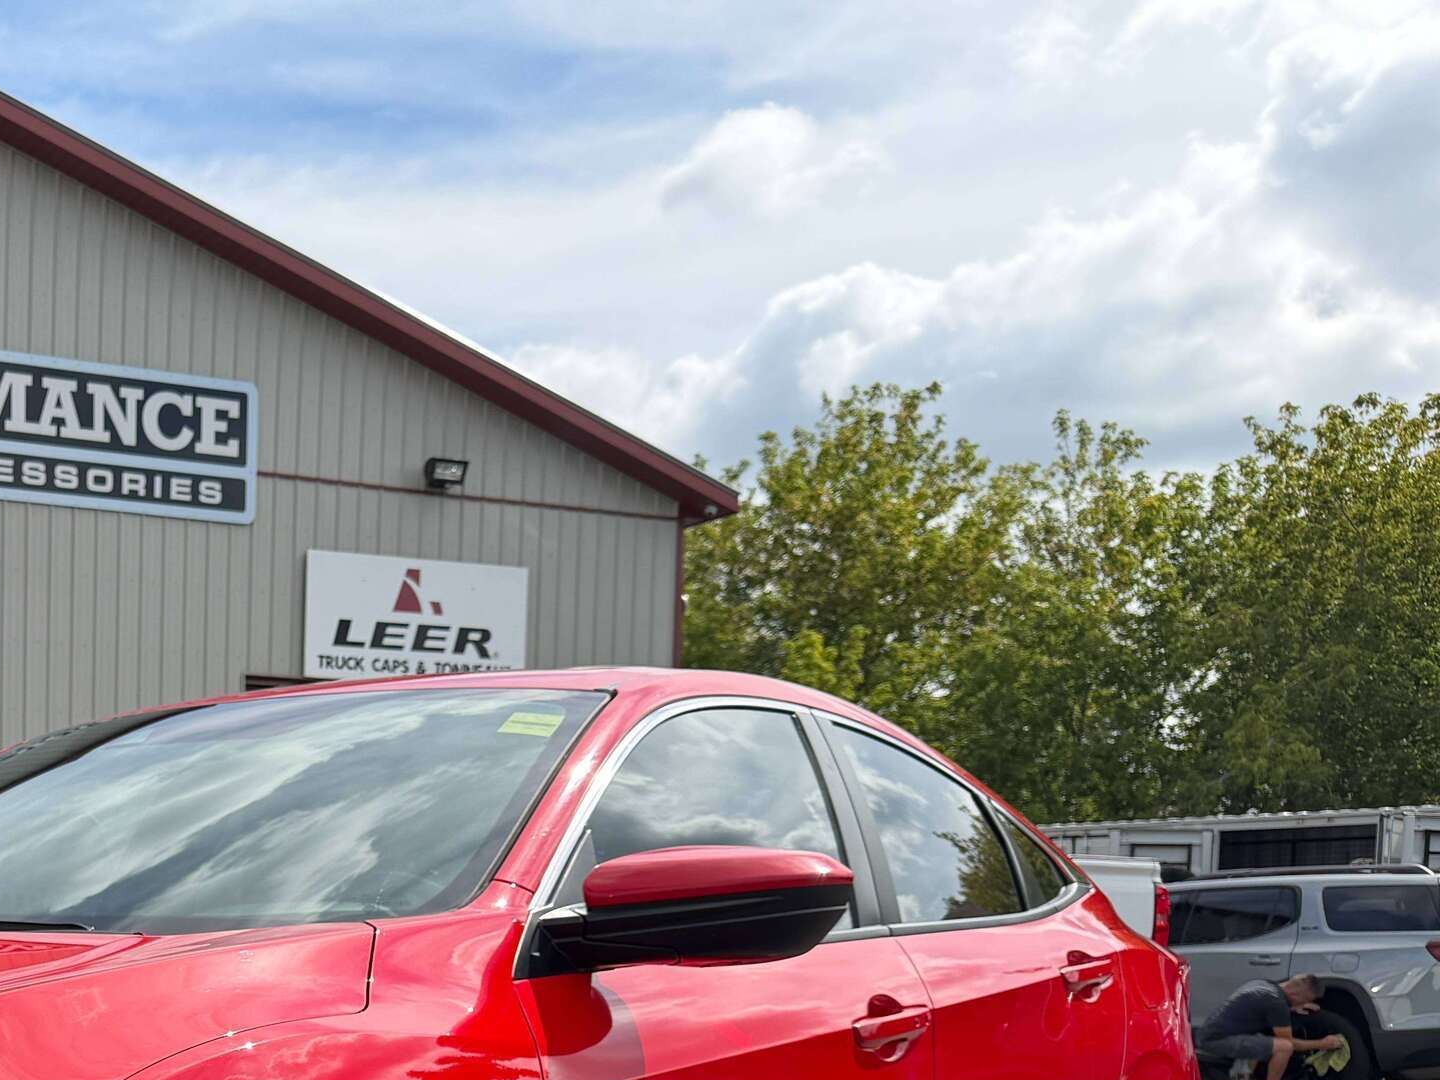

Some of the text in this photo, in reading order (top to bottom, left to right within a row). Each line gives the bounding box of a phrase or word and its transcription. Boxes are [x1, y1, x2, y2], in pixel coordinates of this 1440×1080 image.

[333, 618, 492, 660] LEER
[317, 655, 364, 672] TRUCK
[372, 658, 409, 674] CAPS
[416, 661, 426, 674] &
